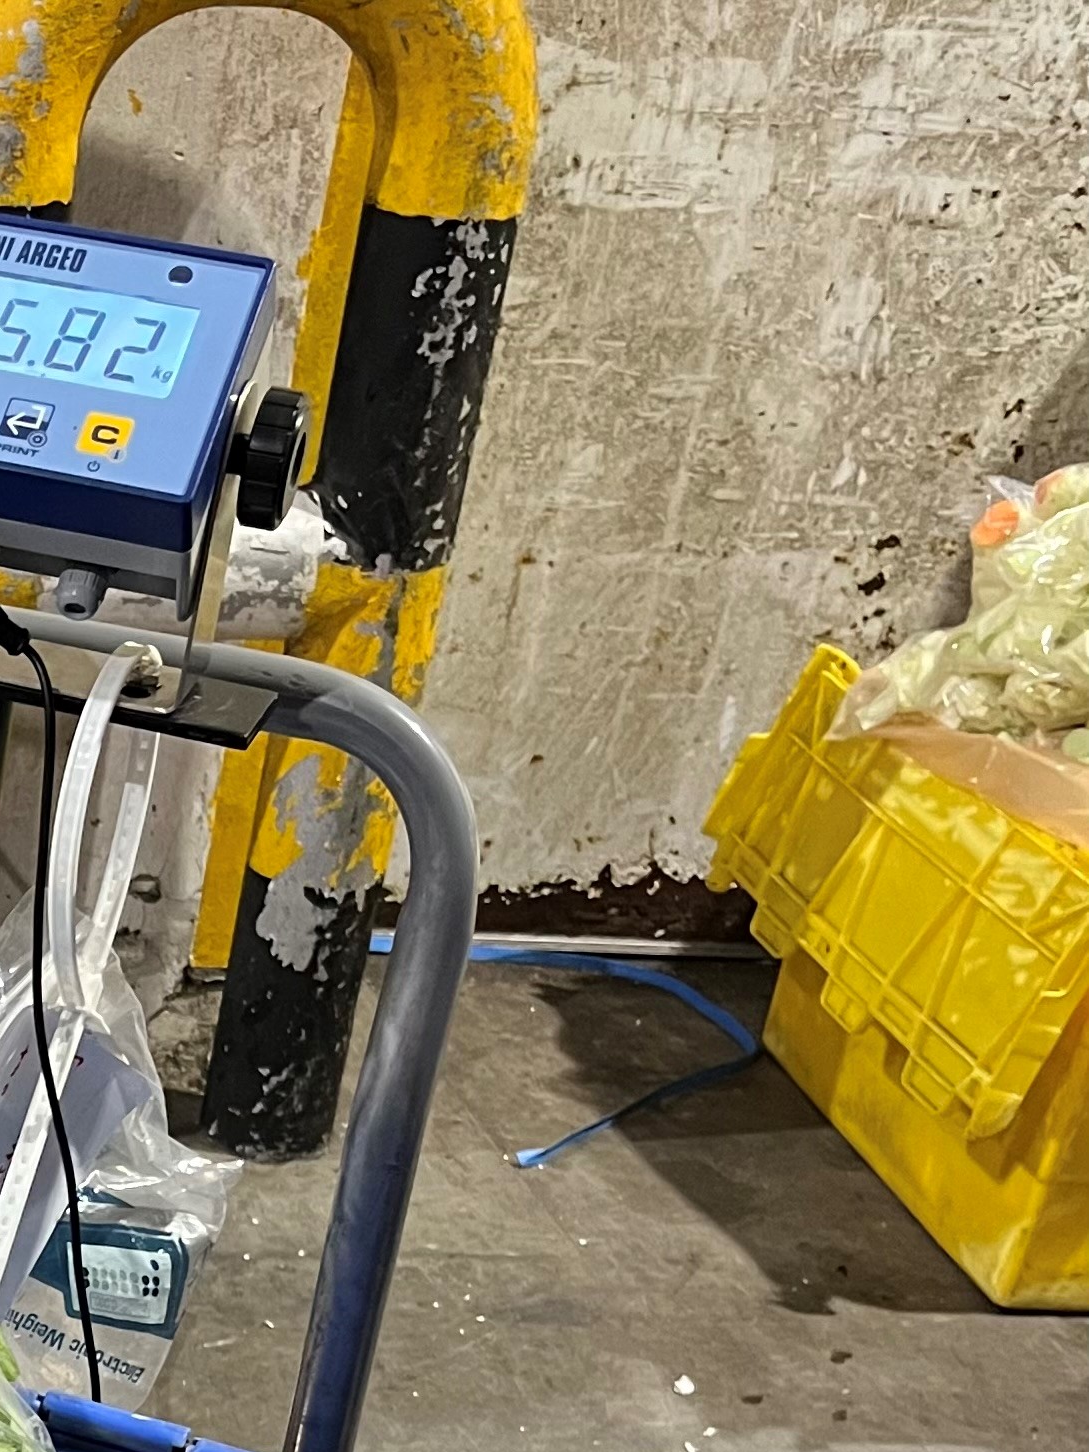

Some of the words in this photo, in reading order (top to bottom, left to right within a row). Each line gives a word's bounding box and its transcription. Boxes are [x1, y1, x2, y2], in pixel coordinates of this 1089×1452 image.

[15, 242, 87, 273] ARGEO
[151, 365, 174, 384] kg
[91, 425, 120, 445] C
[68, 1338, 145, 1383] Electroic
